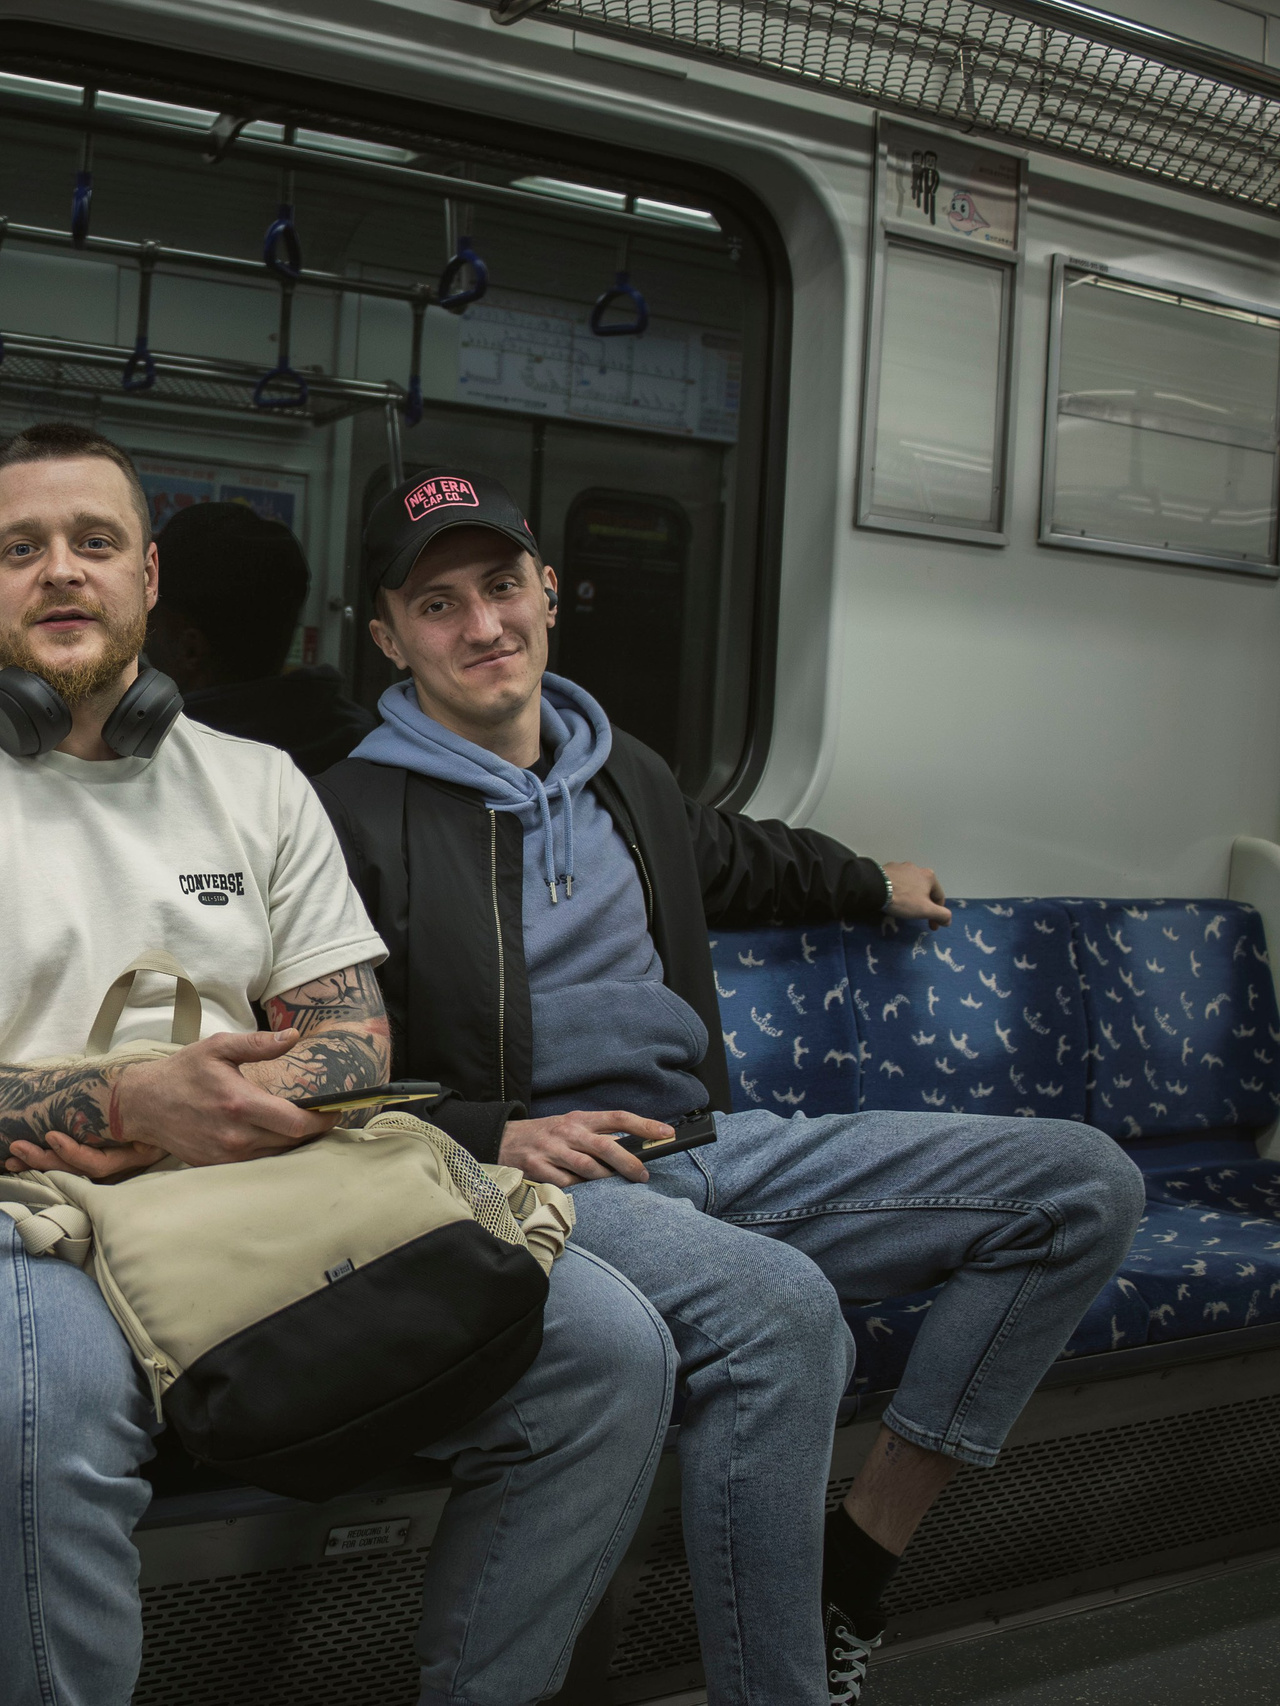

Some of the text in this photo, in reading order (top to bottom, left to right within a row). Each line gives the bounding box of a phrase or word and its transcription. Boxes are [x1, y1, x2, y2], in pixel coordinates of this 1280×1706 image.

[409, 480, 471, 508] NEW ERA
[423, 492, 463, 509] CAP CO.
[179, 872, 244, 896] CONVERSE
[347, 1527, 382, 1538] REDUCING
[342, 1536, 390, 1549] FOR CONTROL
